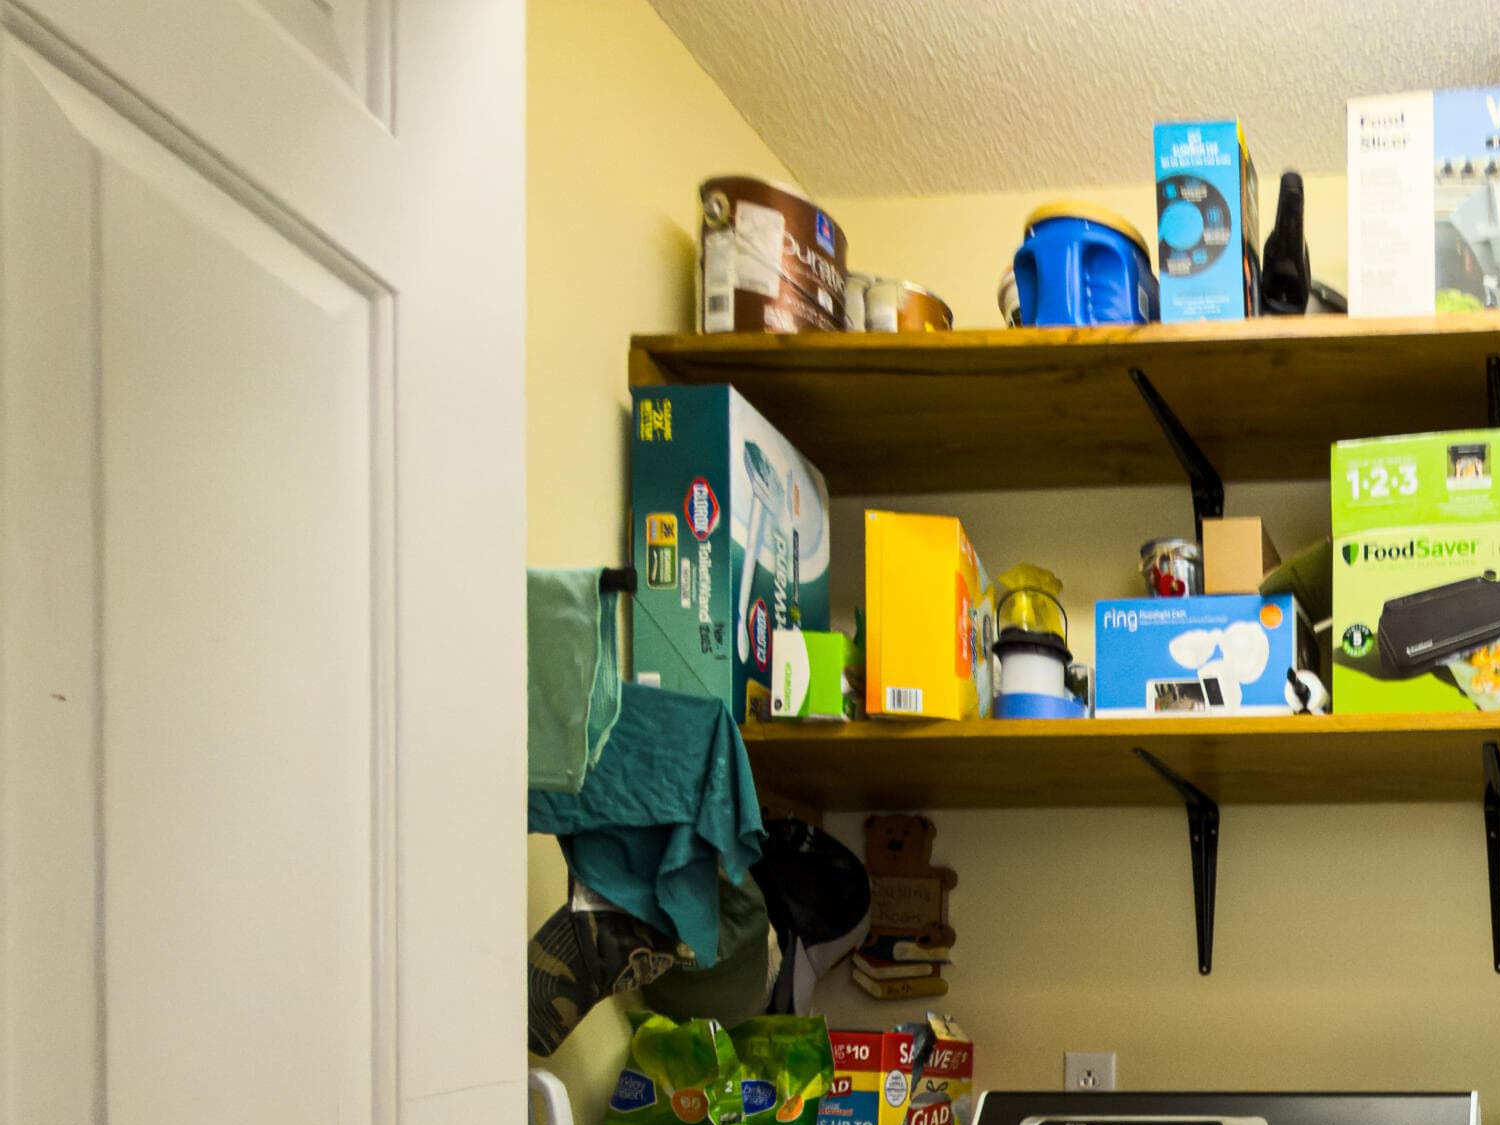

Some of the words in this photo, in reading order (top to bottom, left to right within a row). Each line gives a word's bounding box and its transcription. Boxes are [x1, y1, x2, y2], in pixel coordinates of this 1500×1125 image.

[1360, 112, 1405, 130] Food
[692, 484, 709, 533] CLOROX
[1363, 536, 1479, 562] FoodSaver
[698, 540, 714, 624] ToiletWand
[1103, 607, 1138, 632] ring
[756, 606, 768, 665] CLOROX
[846, 1044, 870, 1061] $10
